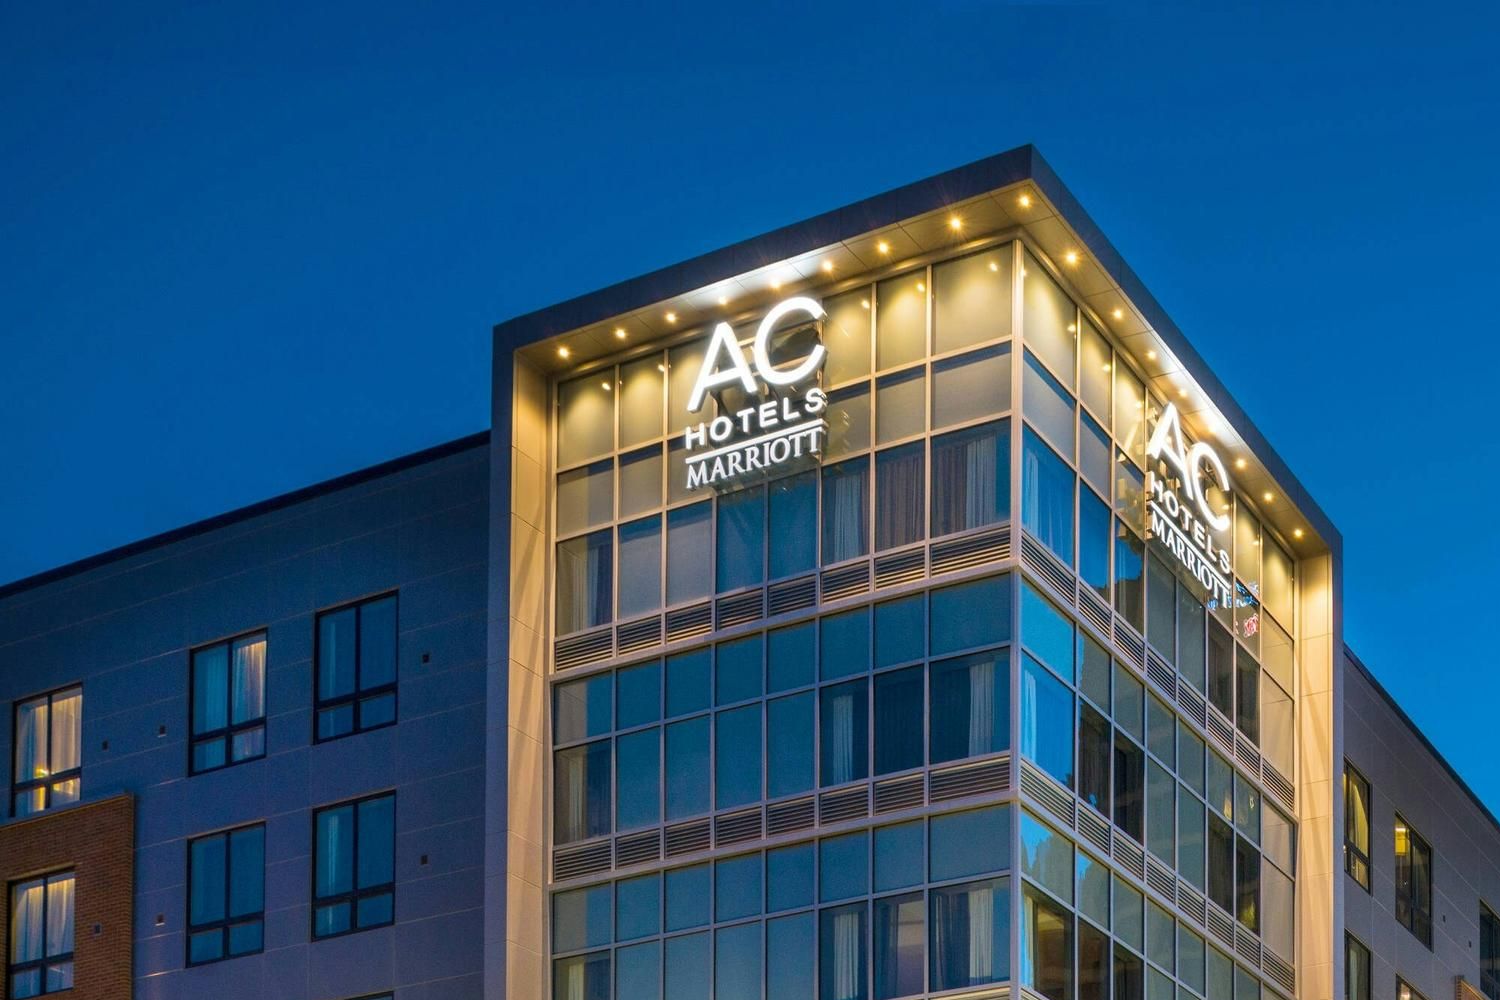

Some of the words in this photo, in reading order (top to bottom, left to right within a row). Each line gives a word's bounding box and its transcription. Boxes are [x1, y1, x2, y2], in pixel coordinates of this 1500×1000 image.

[687, 297, 827, 412] AC
[685, 388, 828, 449] HOTELS
[686, 427, 825, 490] MARRIOTT
[1148, 402, 1231, 531] AC
[1148, 475, 1231, 574] HOTELS
[1151, 511, 1231, 608] MARRIOTT
